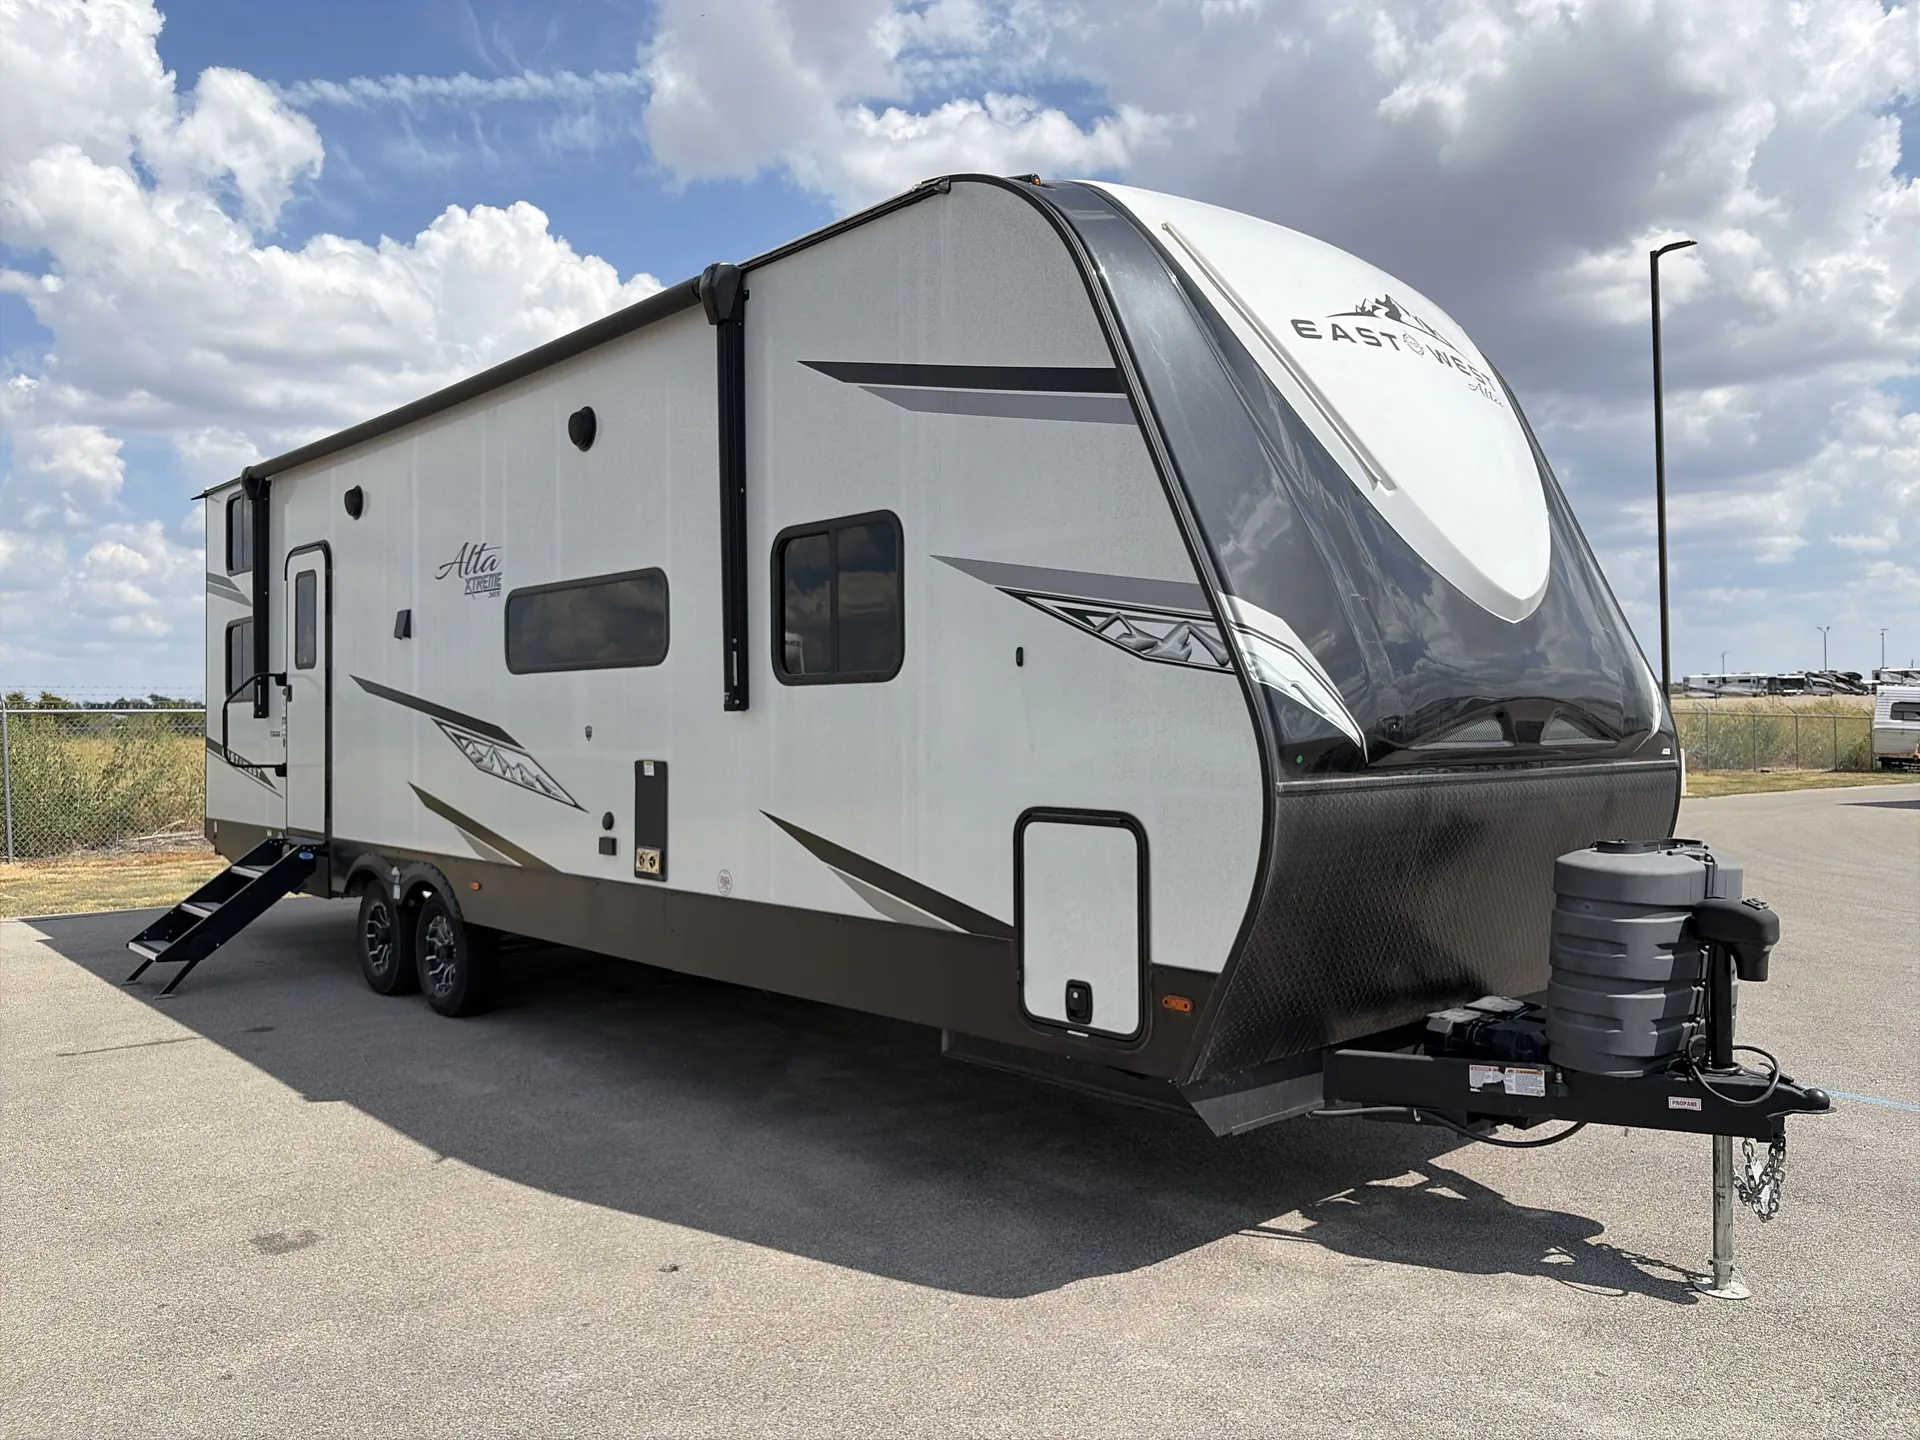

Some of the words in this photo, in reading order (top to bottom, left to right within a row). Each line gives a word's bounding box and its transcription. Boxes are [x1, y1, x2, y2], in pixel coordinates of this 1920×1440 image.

[1290, 319, 1400, 351] EAST
[1426, 344, 1497, 392] WEST
[1466, 383, 1504, 407] Alta
[435, 542, 502, 580] Alta
[464, 572, 502, 599] XTREME
[1672, 1100, 1698, 1108] PROPANE
